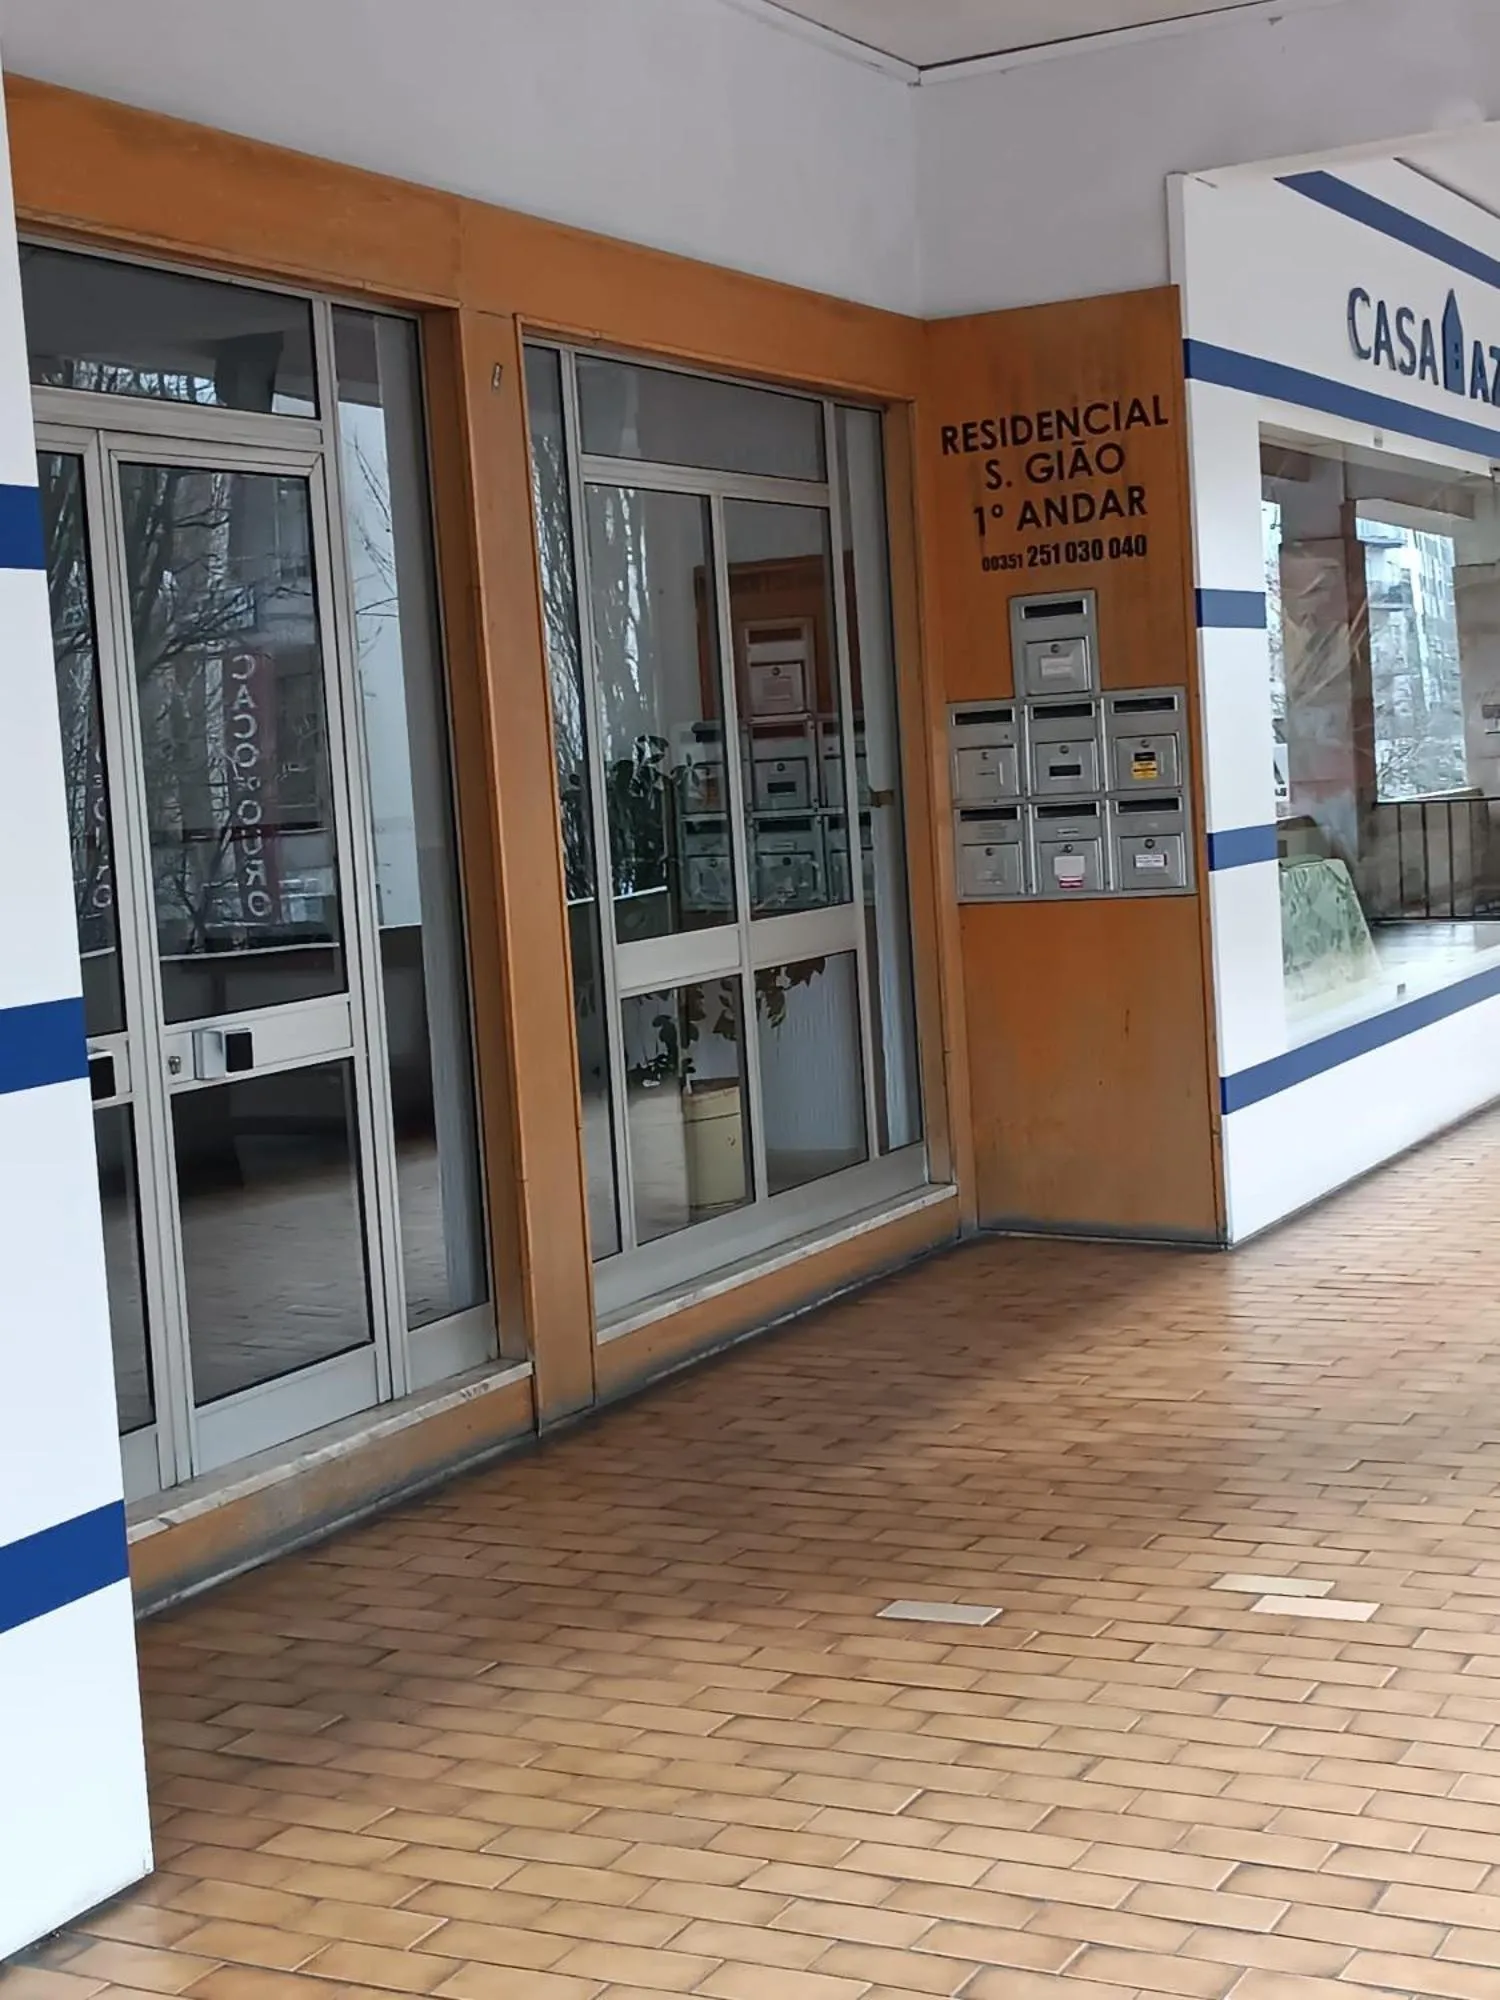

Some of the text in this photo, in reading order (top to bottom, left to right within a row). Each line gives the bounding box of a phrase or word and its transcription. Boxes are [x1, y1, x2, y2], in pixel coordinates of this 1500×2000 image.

[1347, 287, 1440, 386] CASA
[941, 395, 1169, 455] RESIDENCIAL
[985, 439, 1126, 490] S. GIÃO
[1017, 485, 1149, 532] ANDAR
[982, 553, 1023, 573] 00351
[1109, 534, 1147, 560] 040
